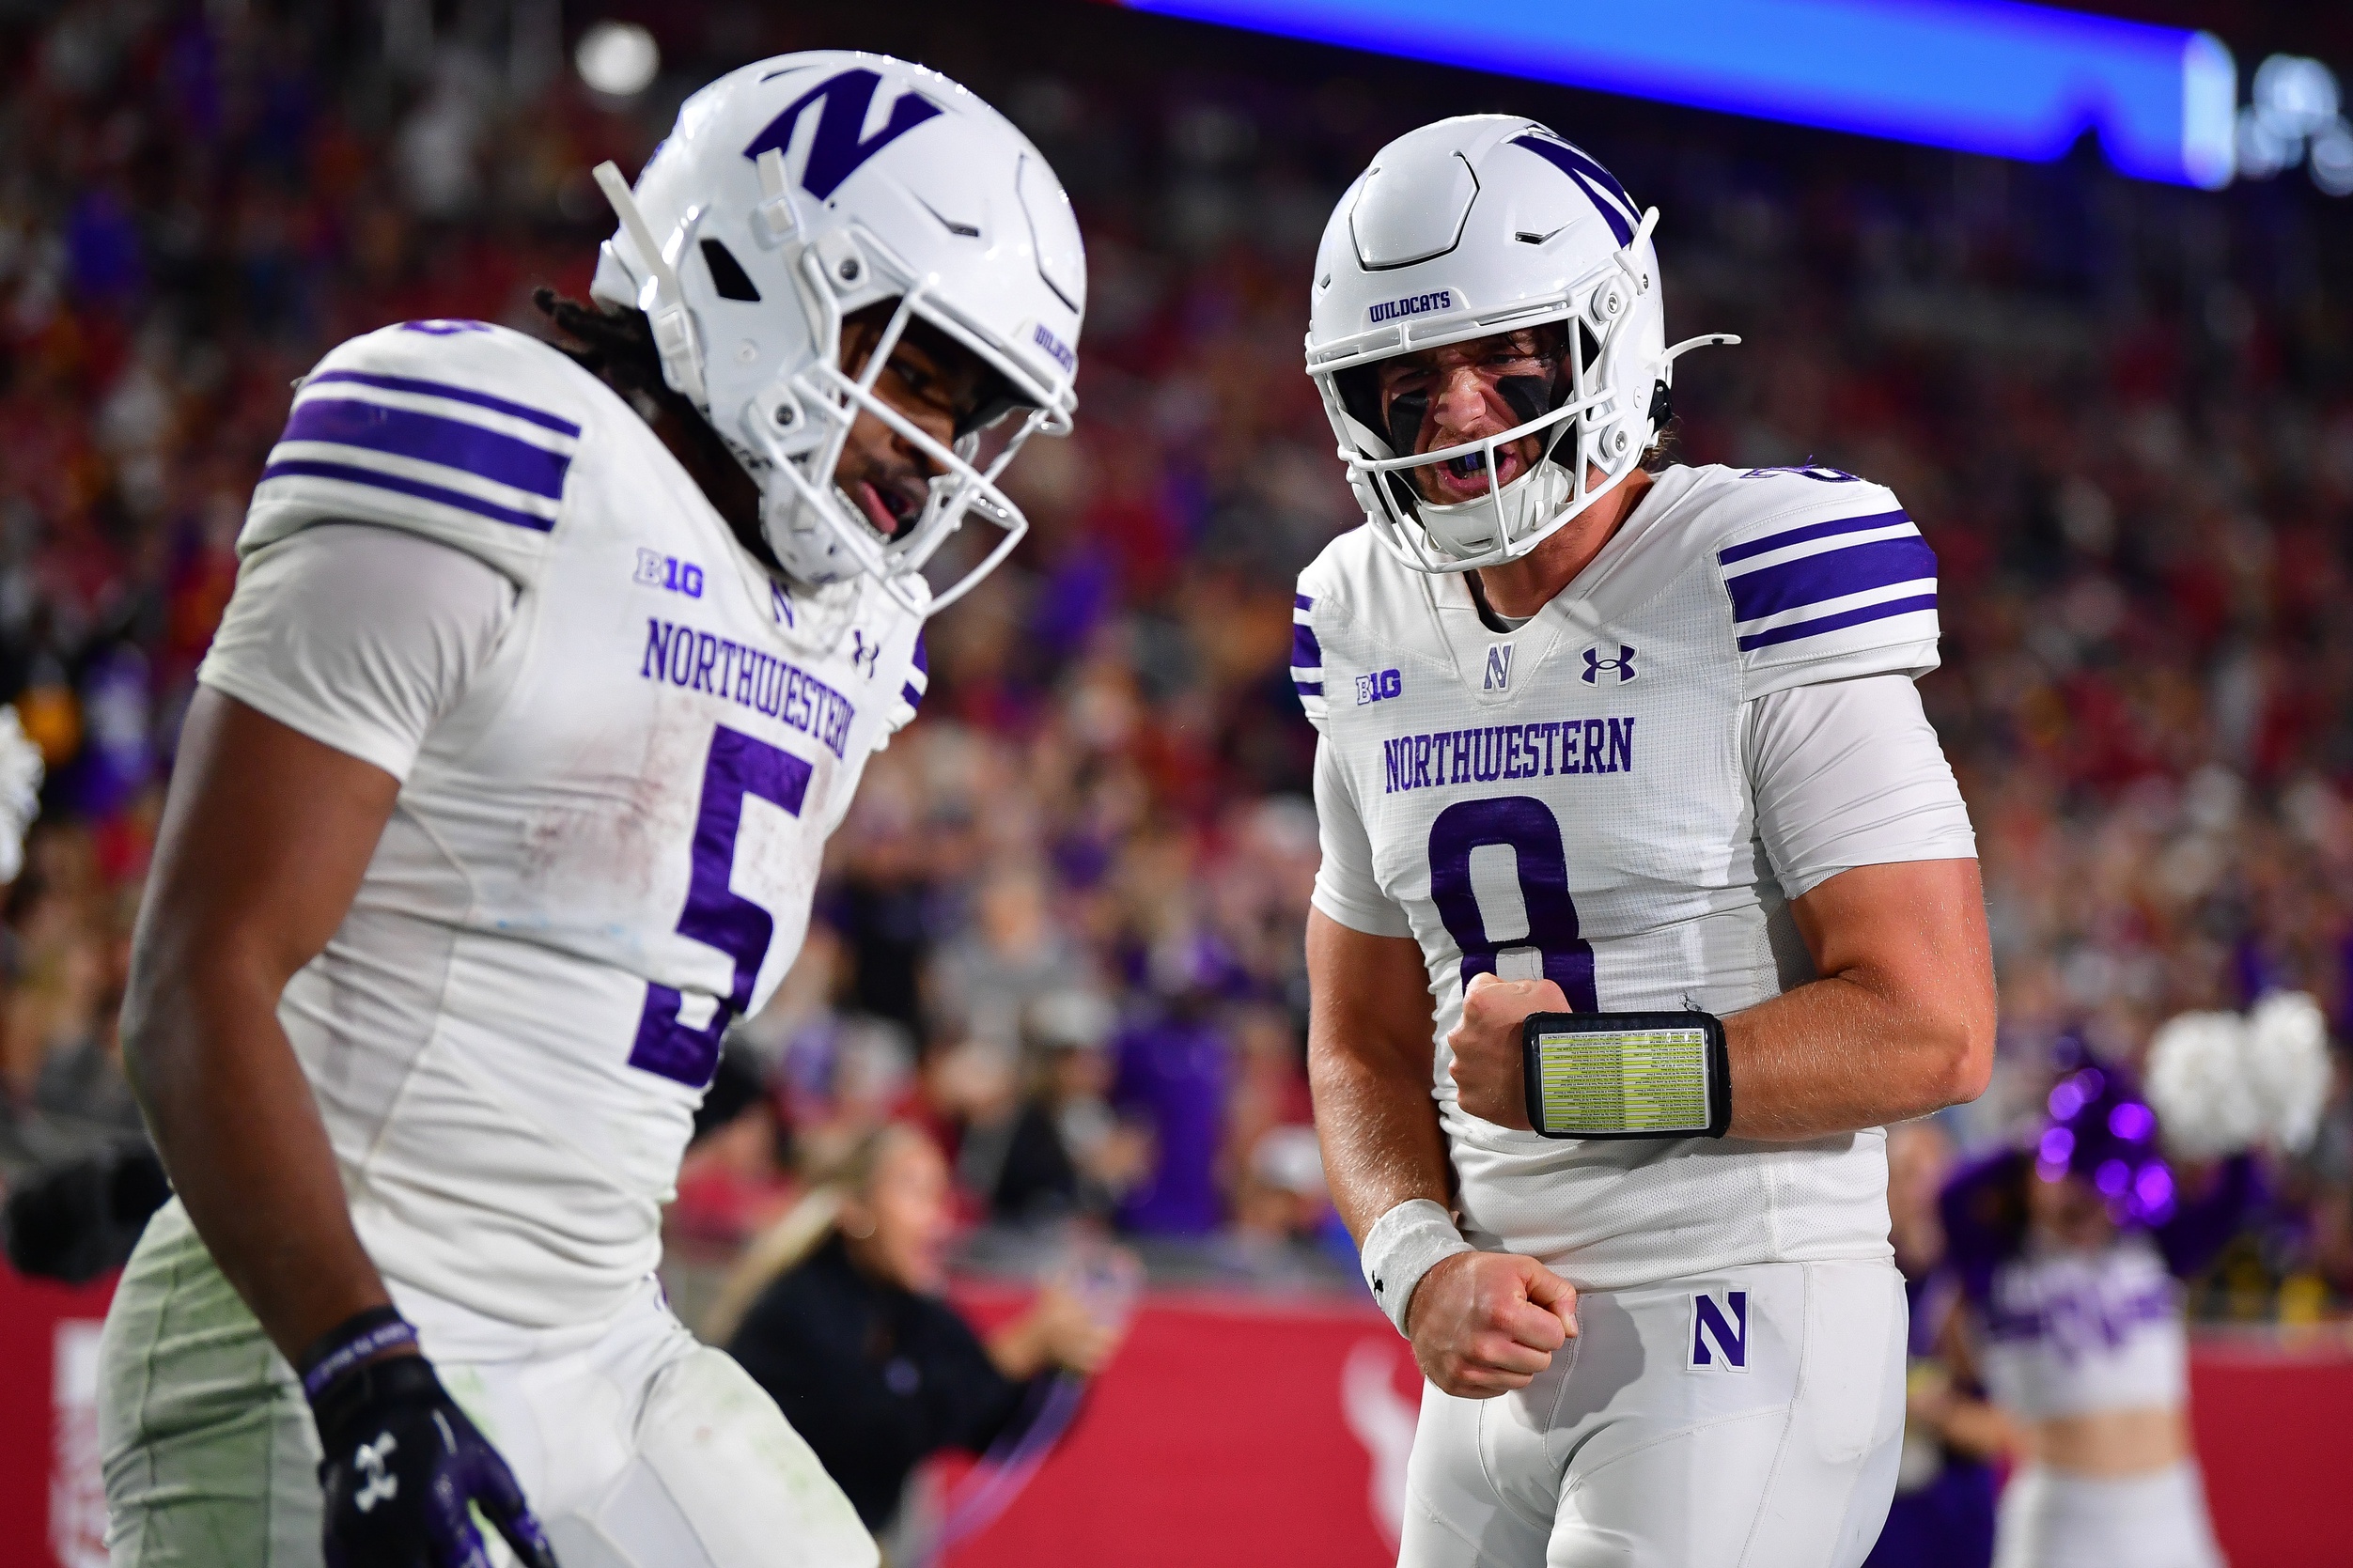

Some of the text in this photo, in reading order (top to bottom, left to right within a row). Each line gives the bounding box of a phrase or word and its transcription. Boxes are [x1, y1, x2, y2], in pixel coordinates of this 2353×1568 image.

[743, 68, 944, 201] N
[1368, 290, 1452, 324] WILDCATS
[640, 616, 856, 762] NORTHWESTERN
[1482, 643, 1515, 692] N
[1383, 716, 1636, 795] NORTHWESTERN
[628, 721, 814, 1088] 5
[1691, 1290, 1748, 1369] N
